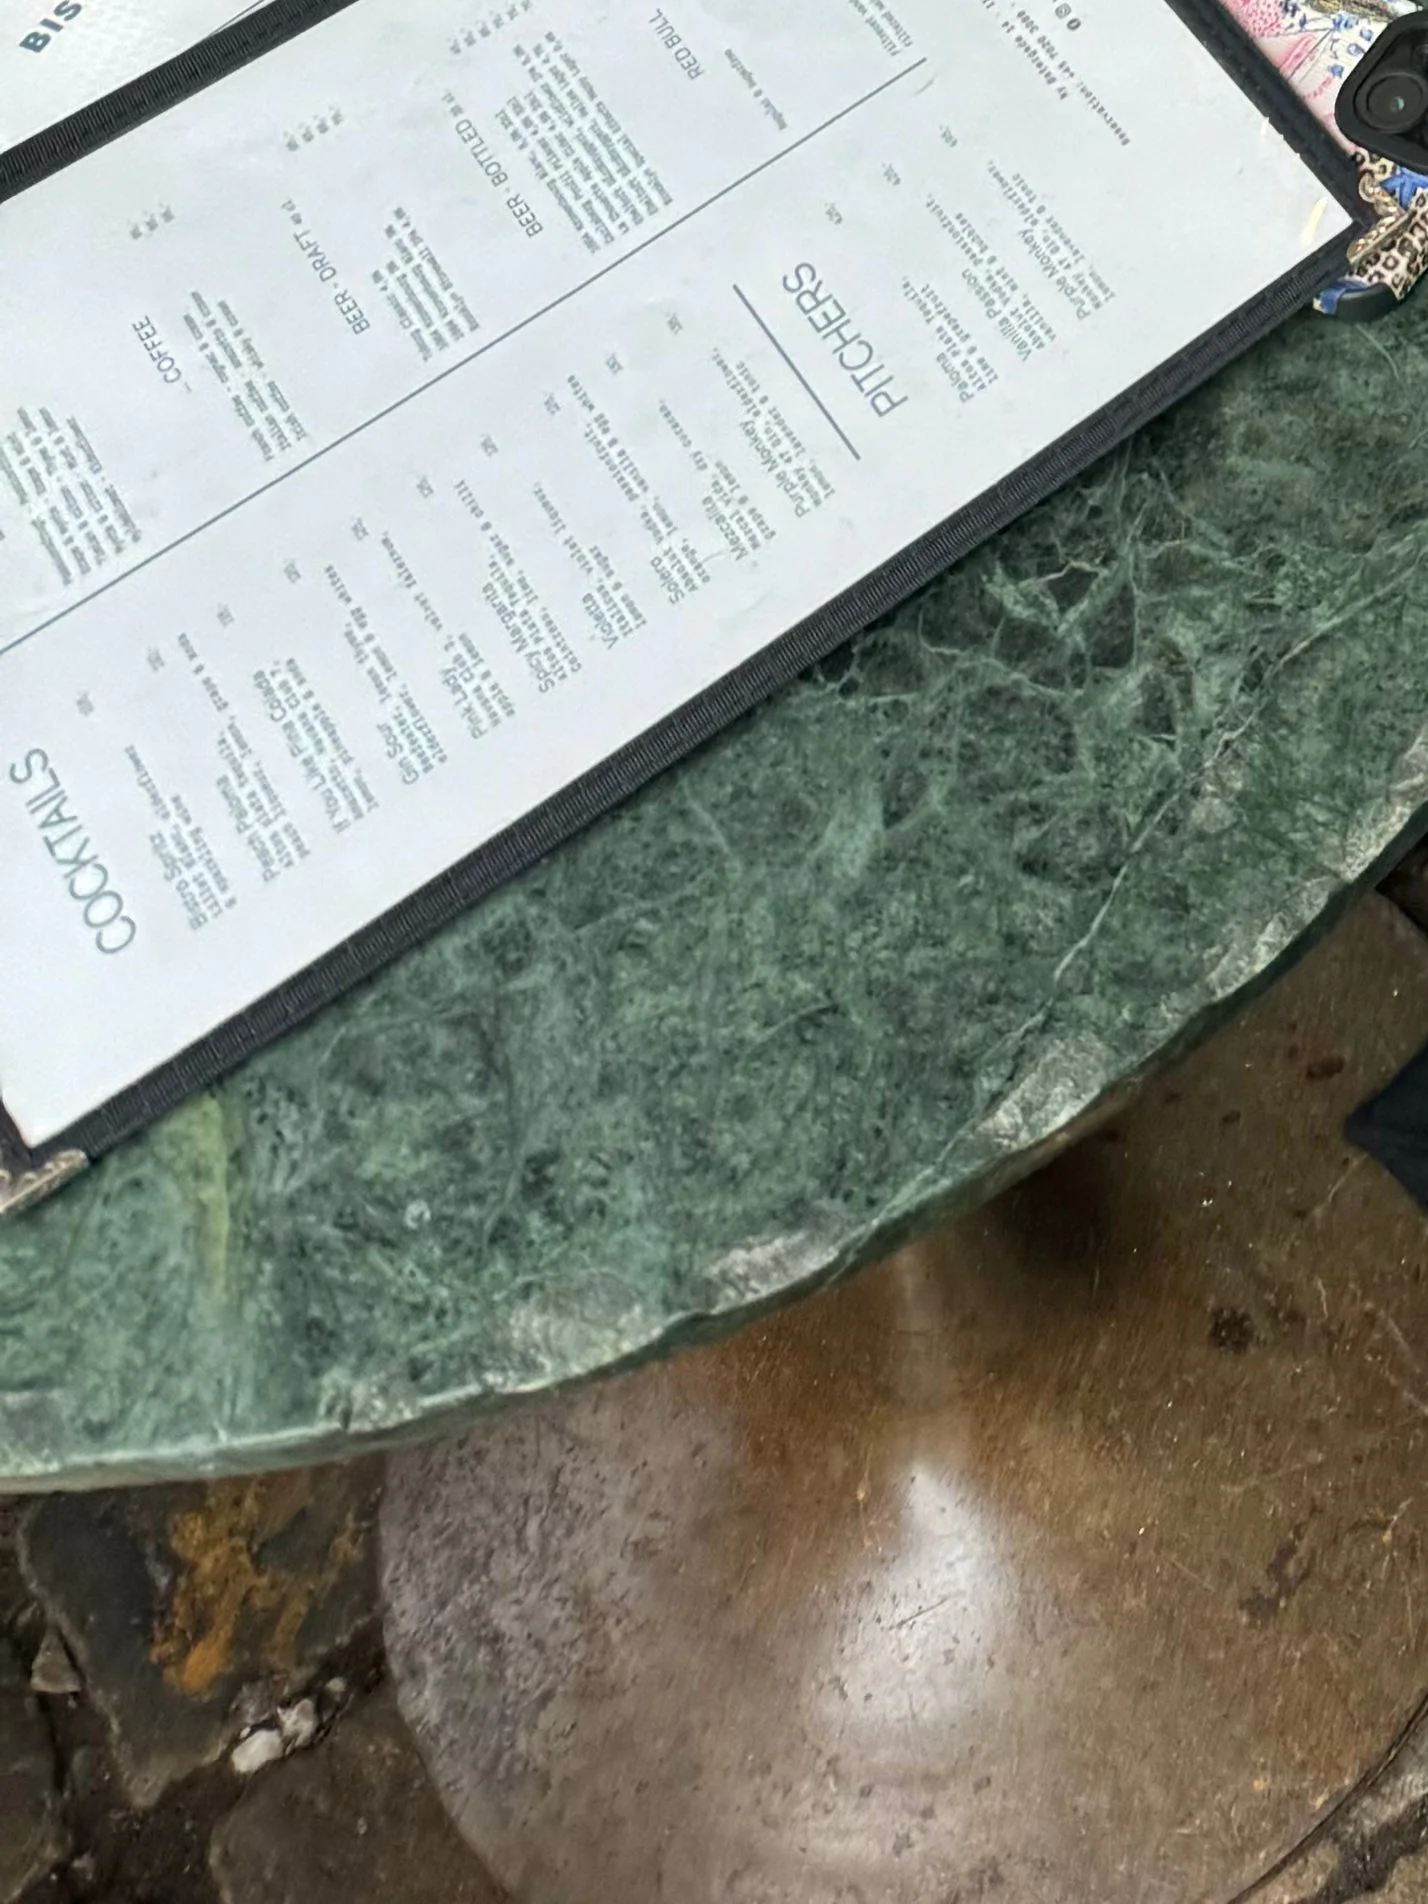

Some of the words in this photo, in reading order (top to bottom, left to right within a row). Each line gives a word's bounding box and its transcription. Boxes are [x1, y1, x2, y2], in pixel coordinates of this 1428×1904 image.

[647, 7, 682, 50] BULL
[673, 45, 705, 80] RED
[454, 118, 508, 187] BOTTLED
[505, 192, 544, 238] BEER
[292, 229, 337, 283] DRAFT
[1016, 228, 1059, 279] Monkey
[333, 288, 371, 335] BEER
[960, 267, 1002, 319] Passion
[1054, 275, 1091, 320] Purple
[131, 315, 182, 384] COFFEE
[781, 261, 907, 417] PITCHERS
[997, 316, 1032, 362] Vanilla
[935, 351, 975, 403] Paloma
[738, 419, 779, 473] Monkey
[774, 469, 811, 518] Purple
[701, 495, 748, 561] Mezcalita
[649, 555, 685, 605] Solero
[481, 581, 529, 653] Margarita
[581, 592, 619, 650] Violetta
[252, 669, 287, 723] Colada
[439, 666, 468, 706] Lady
[523, 649, 556, 694] Spicy
[375, 722, 404, 759] Sour
[459, 702, 488, 740] Pink
[299, 754, 326, 791] Like
[397, 755, 420, 785] Gin
[215, 774, 251, 835] Paloma
[319, 787, 340, 821] You
[330, 817, 351, 834] If
[8, 748, 136, 954] COCKTAILS
[148, 830, 182, 882] Spritz
[246, 831, 280, 883] Peach
[175, 878, 208, 931] Bistro
